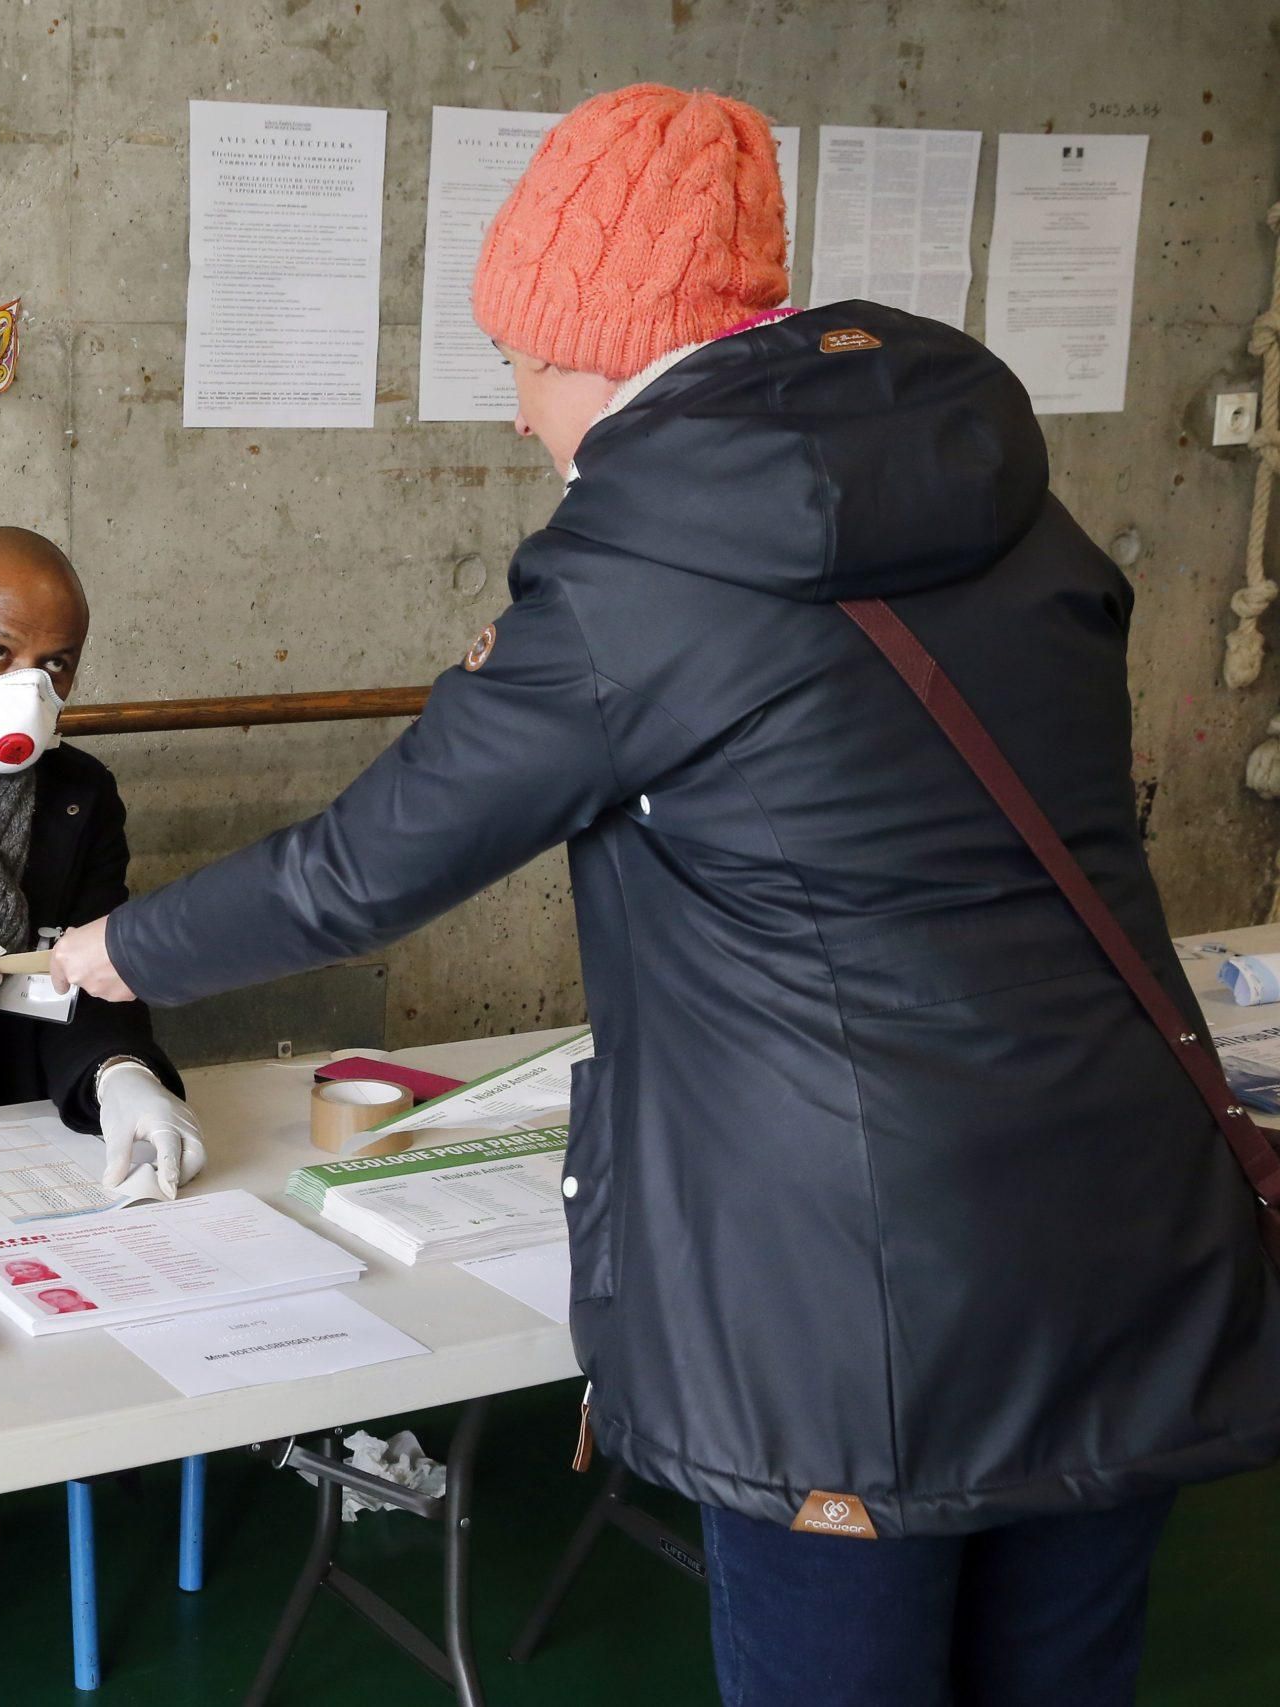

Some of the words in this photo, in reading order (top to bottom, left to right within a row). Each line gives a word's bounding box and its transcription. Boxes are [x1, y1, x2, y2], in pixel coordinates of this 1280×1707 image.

[219, 136, 246, 144] AVIS
[429, 1142, 486, 1162] POUR
[483, 1131, 543, 1151] PARIS
[204, 1352, 230, 1362] Mme
[312, 1332, 349, 1342] Corinne
